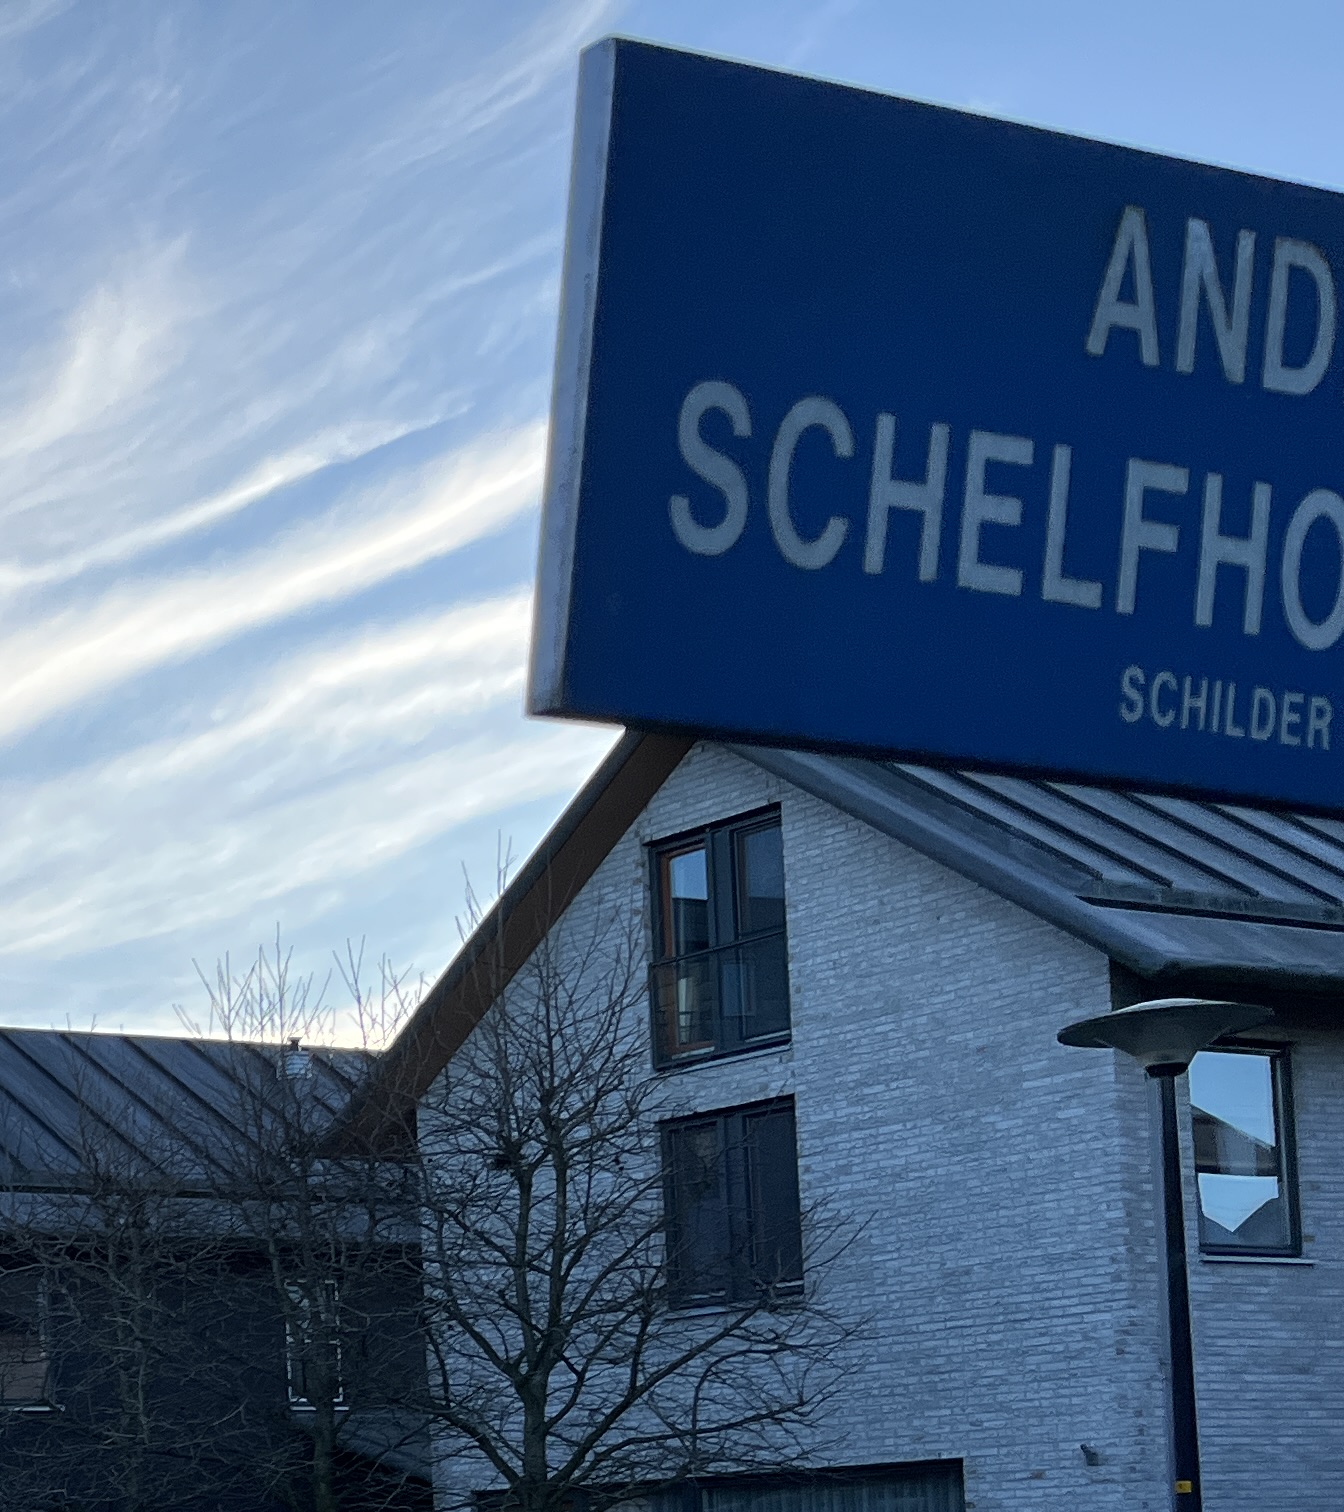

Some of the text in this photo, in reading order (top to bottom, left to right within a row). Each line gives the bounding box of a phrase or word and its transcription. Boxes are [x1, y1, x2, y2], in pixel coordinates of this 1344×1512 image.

[1085, 204, 1336, 395] AND
[670, 380, 1344, 650] SCHELFHO
[1120, 664, 1334, 750] SCHILDER
